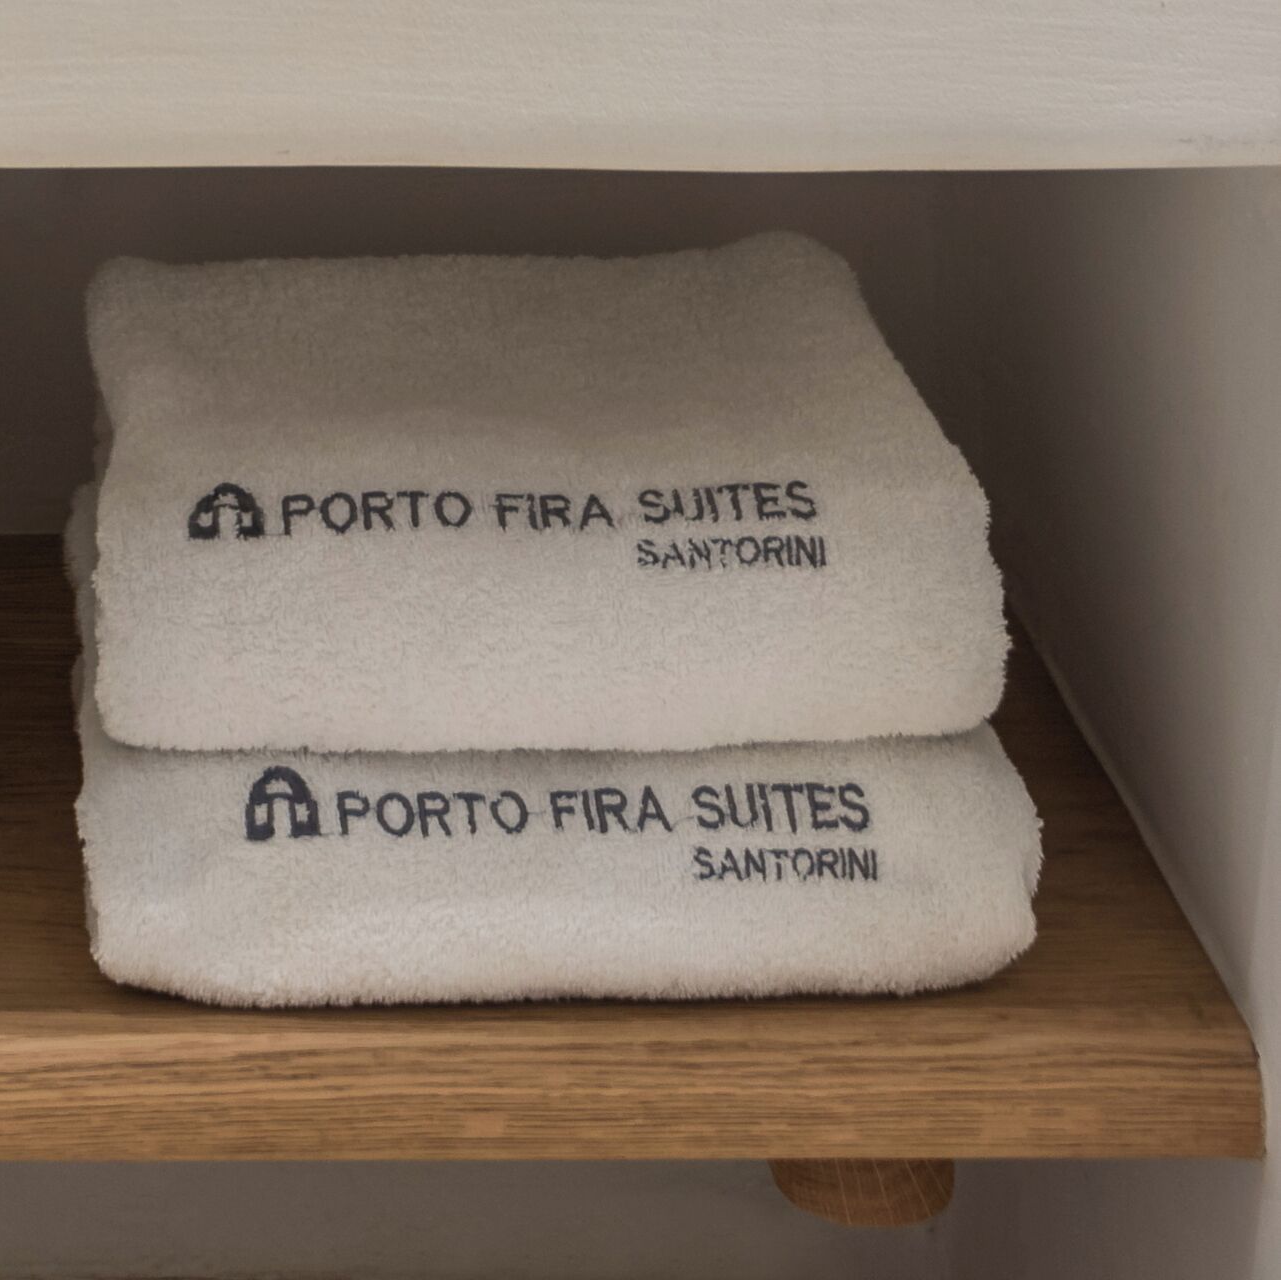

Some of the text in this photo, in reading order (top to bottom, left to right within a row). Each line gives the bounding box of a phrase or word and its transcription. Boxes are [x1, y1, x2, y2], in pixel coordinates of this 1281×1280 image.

[281, 480, 818, 536] PORTO FIRA SUITES
[636, 537, 827, 569] SANTORINI
[337, 783, 870, 837] PORTO FIRA SUITES
[693, 847, 878, 881] SANTORINI
